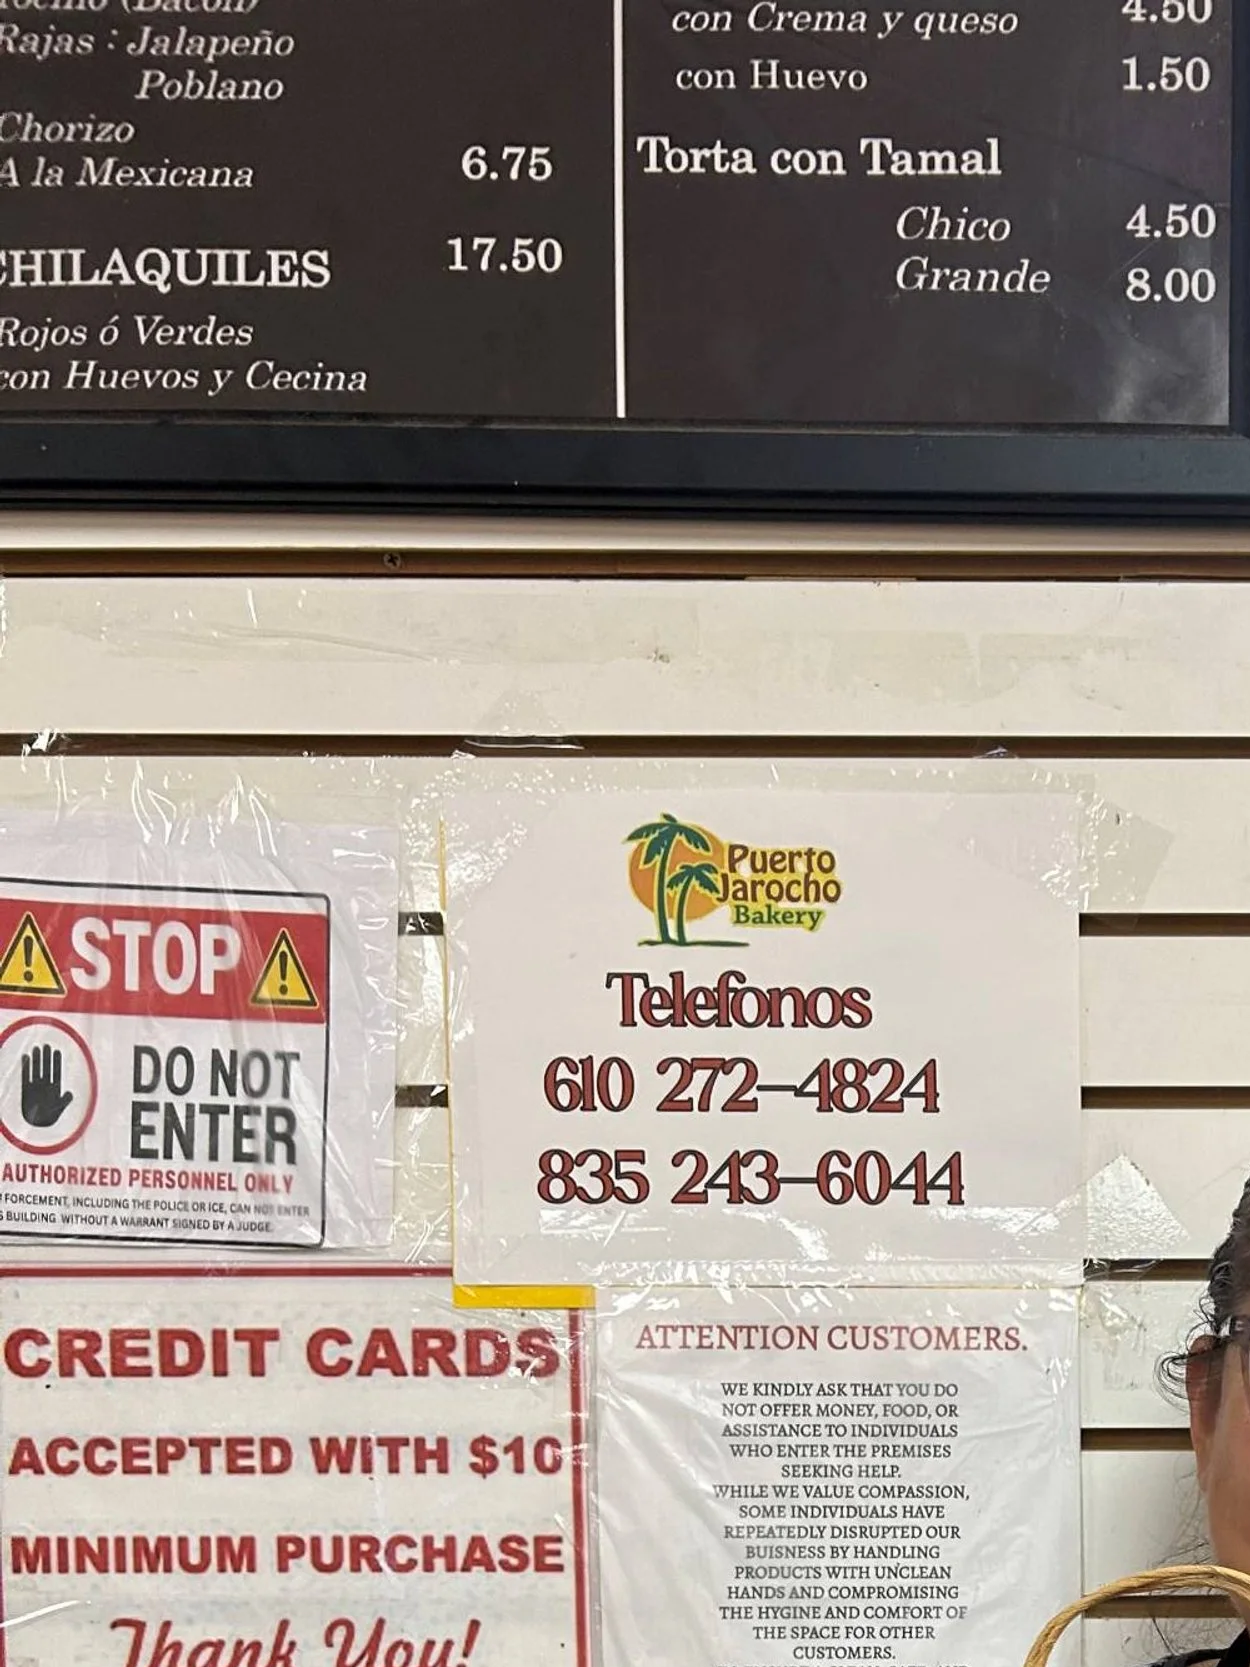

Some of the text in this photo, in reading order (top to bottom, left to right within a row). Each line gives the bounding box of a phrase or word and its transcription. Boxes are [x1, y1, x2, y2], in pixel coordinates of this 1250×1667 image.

[672, 2, 1018, 40] con Crema y queso
[1122, 0, 1212, 23] 4.50
[0, 24, 294, 63] Rajas Jalapeño
[135, 70, 283, 99] Poblano
[677, 60, 867, 90] con Huevo
[1123, 57, 1210, 91] 1.50
[0, 112, 134, 142] Chorizo
[0, 156, 253, 187] A la Mexicana
[462, 146, 552, 181] 6.75
[637, 137, 1001, 175] Torta con Tamal
[897, 207, 1010, 241] Chico
[1126, 204, 1215, 238] 4.50
[0, 248, 330, 293] HILAQUILES
[448, 238, 562, 272] 17.50
[897, 256, 1050, 292] Grande
[1127, 268, 1215, 302] 8.00
[0, 315, 253, 352] Rojos ó Verdes
[64, 360, 199, 388] Huevos
[208, 370, 233, 396] y
[246, 361, 366, 391] Cecina
[729, 844, 836, 874] Puerto
[717, 872, 841, 903] Jarocho
[732, 905, 825, 930] Bakery
[71, 917, 241, 994] STOP
[605, 970, 872, 1029] Telefonos
[133, 1045, 300, 1099] DO NOT
[544, 1055, 634, 1112] 610
[131, 1101, 296, 1165] ENTER
[2, 1163, 293, 1194] AUTHORIZED PERSONNEL ONLY
[537, 1149, 650, 1204] 835
[6, 1211, 56, 1223] BUILDING
[61, 1214, 108, 1225] WITHOUT
[120, 1217, 169, 1228] WARRANT
[73, 1197, 251, 1214] INCLUDING THE POLICE OR ICE, CAN
[4, 1328, 560, 1378] CREDIT CARDS
[636, 1325, 1027, 1351] ATTENTION CUSTOMERS.
[721, 1383, 958, 1397] WE KINDLY ASK THAT YOU DO
[722, 1403, 958, 1419] NOT OFFER MONEY, FOOD, OR
[722, 1424, 958, 1437] ASSISTANCE TO INDIVIDUALS
[8, 1435, 562, 1479] ACCEPTED WITH $10
[729, 1444, 951, 1458] WHO ENTER THE PREMISES
[782, 1464, 901, 1478] SEEKING HELP.
[713, 1485, 969, 1500] WHILE WE VALUE COMPASSION,
[739, 1505, 944, 1518] SOME INDIVIDUALS HAVE
[724, 1525, 960, 1539] REPEATEDLY DISRUPTED OUR
[11, 1535, 564, 1574] MINIMUM PURCHASE
[746, 1546, 939, 1559] BUISNESS BY HANDLING
[735, 1564, 951, 1579] PRODUCTS WITH UNCLEAN
[728, 1586, 958, 1599] HANDS AND COMPROMISING
